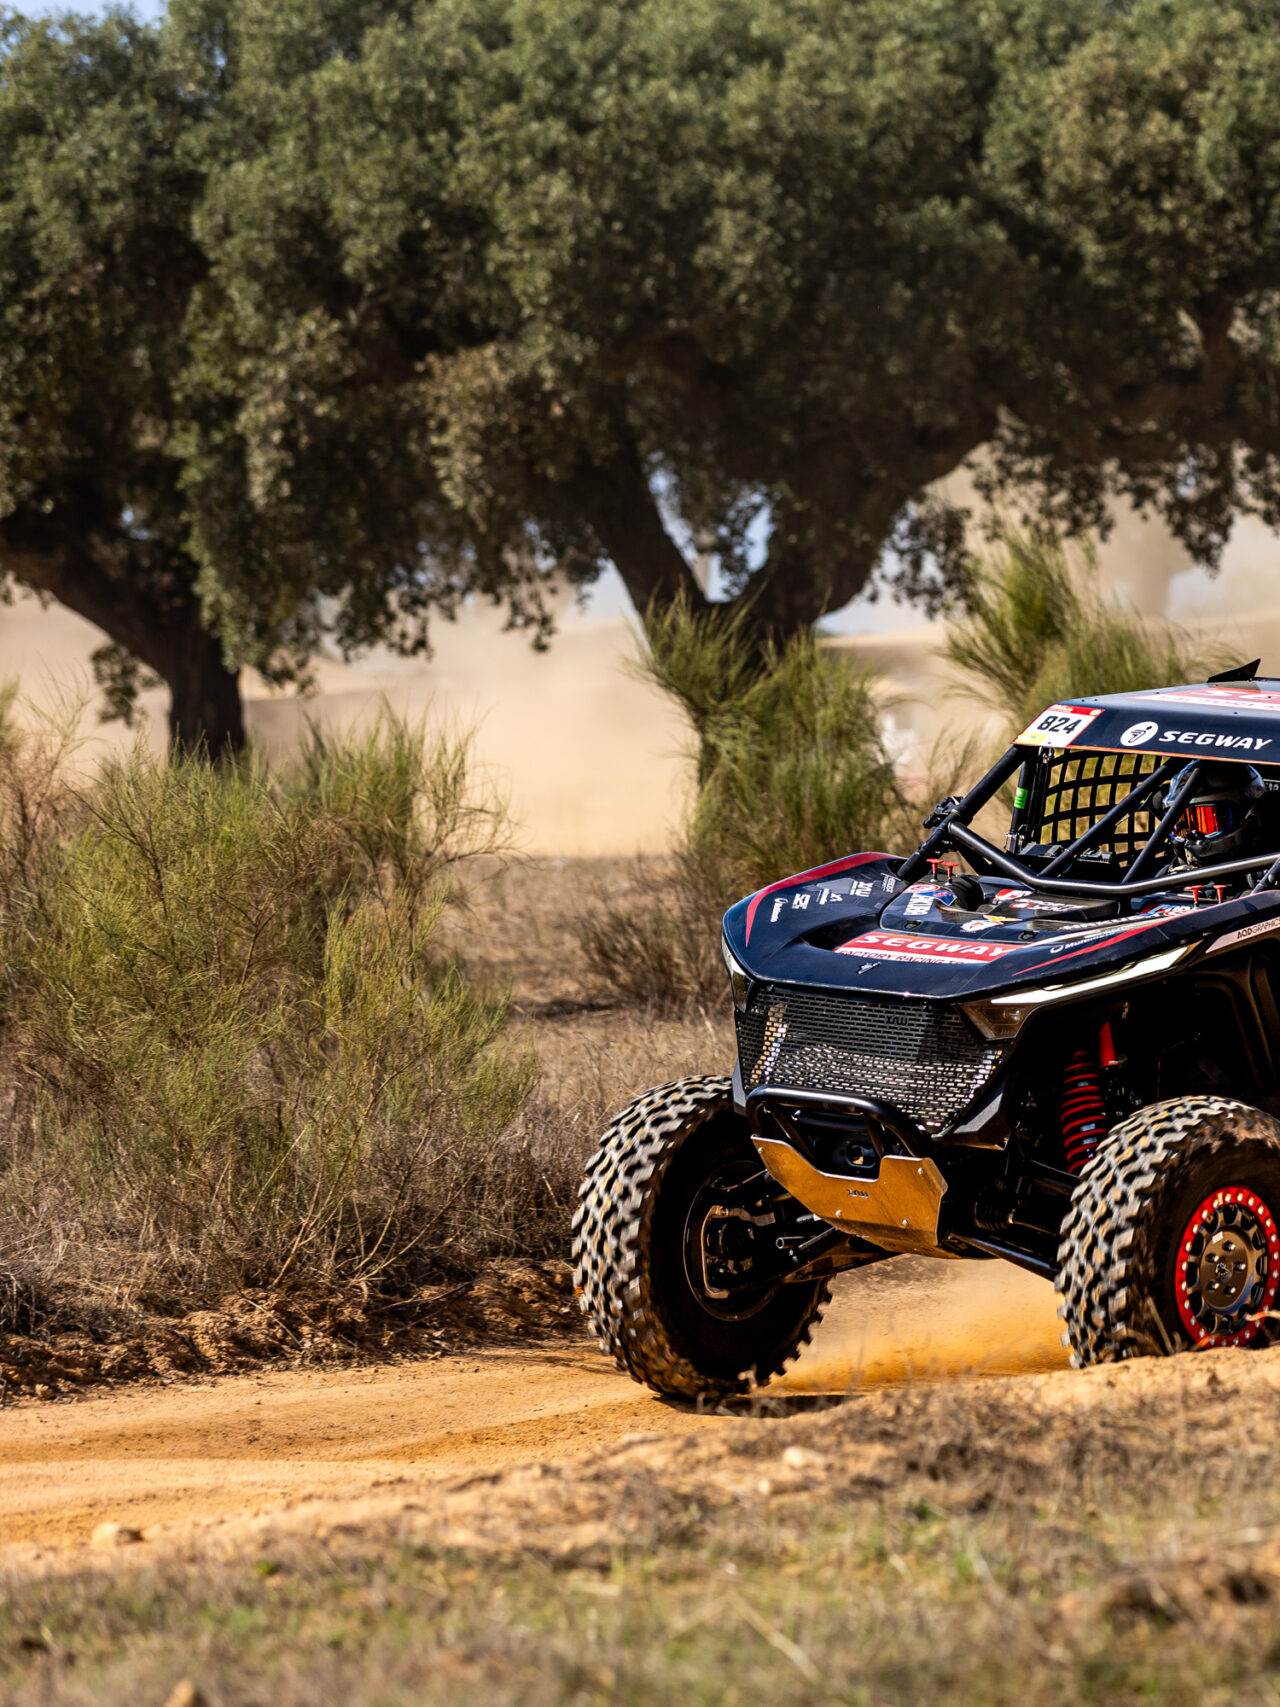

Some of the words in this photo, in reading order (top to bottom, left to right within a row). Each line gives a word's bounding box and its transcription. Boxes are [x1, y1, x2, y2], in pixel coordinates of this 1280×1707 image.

[1037, 715, 1083, 734] 824
[1158, 730, 1272, 750] SEGWAY
[855, 935, 1012, 956] SEGWAY
